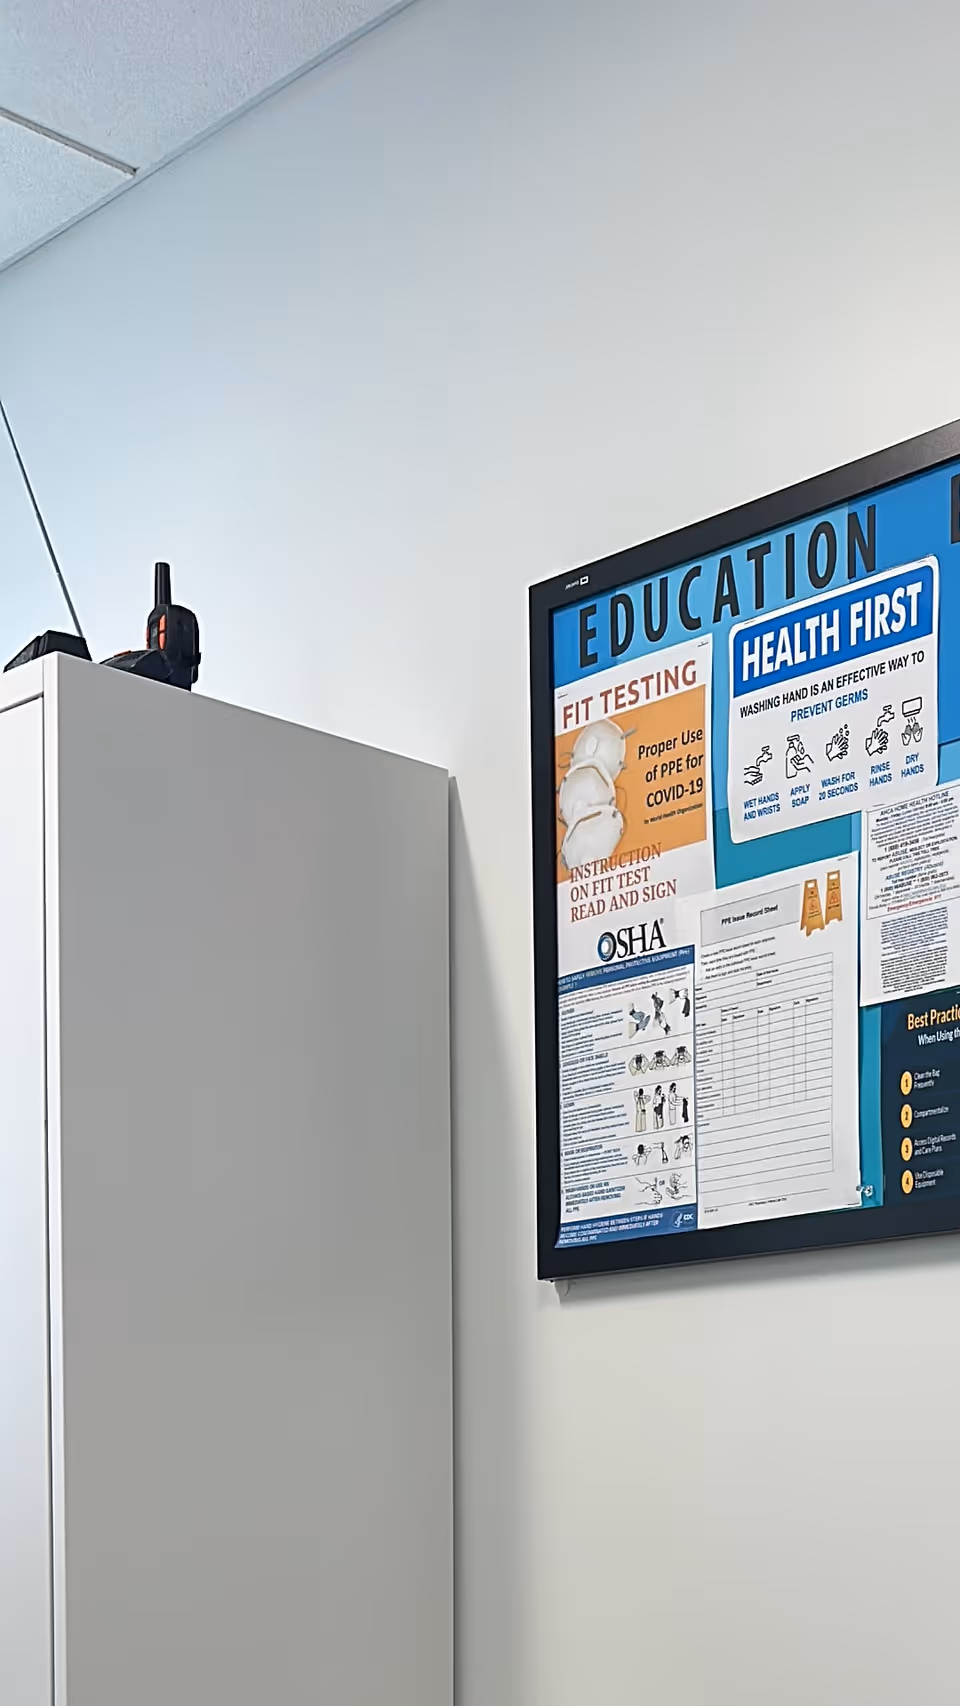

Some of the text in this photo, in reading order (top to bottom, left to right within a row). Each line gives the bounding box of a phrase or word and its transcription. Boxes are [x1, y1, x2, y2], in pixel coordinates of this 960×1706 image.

[579, 504, 877, 669] EDUCATION
[743, 581, 923, 681] HEALTH FIRST
[740, 650, 924, 718] WASHING HAND IS AN EFFECTIVE WAY TO
[563, 660, 696, 729] FIT TESTING
[791, 688, 868, 722] PREVENT GERMS
[638, 729, 703, 760] Proper Use
[906, 752, 919, 765] DRY
[645, 754, 704, 783] of PPE for
[871, 761, 890, 775] RINSE
[901, 763, 924, 778] HANDS
[821, 772, 855, 788] WASH FOR
[870, 773, 892, 787] HANDS
[647, 777, 703, 808] COVID-19
[790, 784, 810, 796] APPLY
[819, 783, 858, 800] 20 SECONDS
[744, 792, 779, 809] WET HANDS
[792, 796, 809, 808] SOAP
[744, 804, 780, 821] AND WRISTS
[570, 842, 662, 883] INSTRUCTION
[571, 866, 650, 902] ON FIT TEST
[571, 879, 677, 922] READ AND SIGN
[721, 904, 778, 926] PPE Issue Record Sheet
[907, 1012, 928, 1030] Best
[918, 1034, 936, 1046] When
[936, 1030, 954, 1042] Using
[905, 1112, 908, 1120] 2
